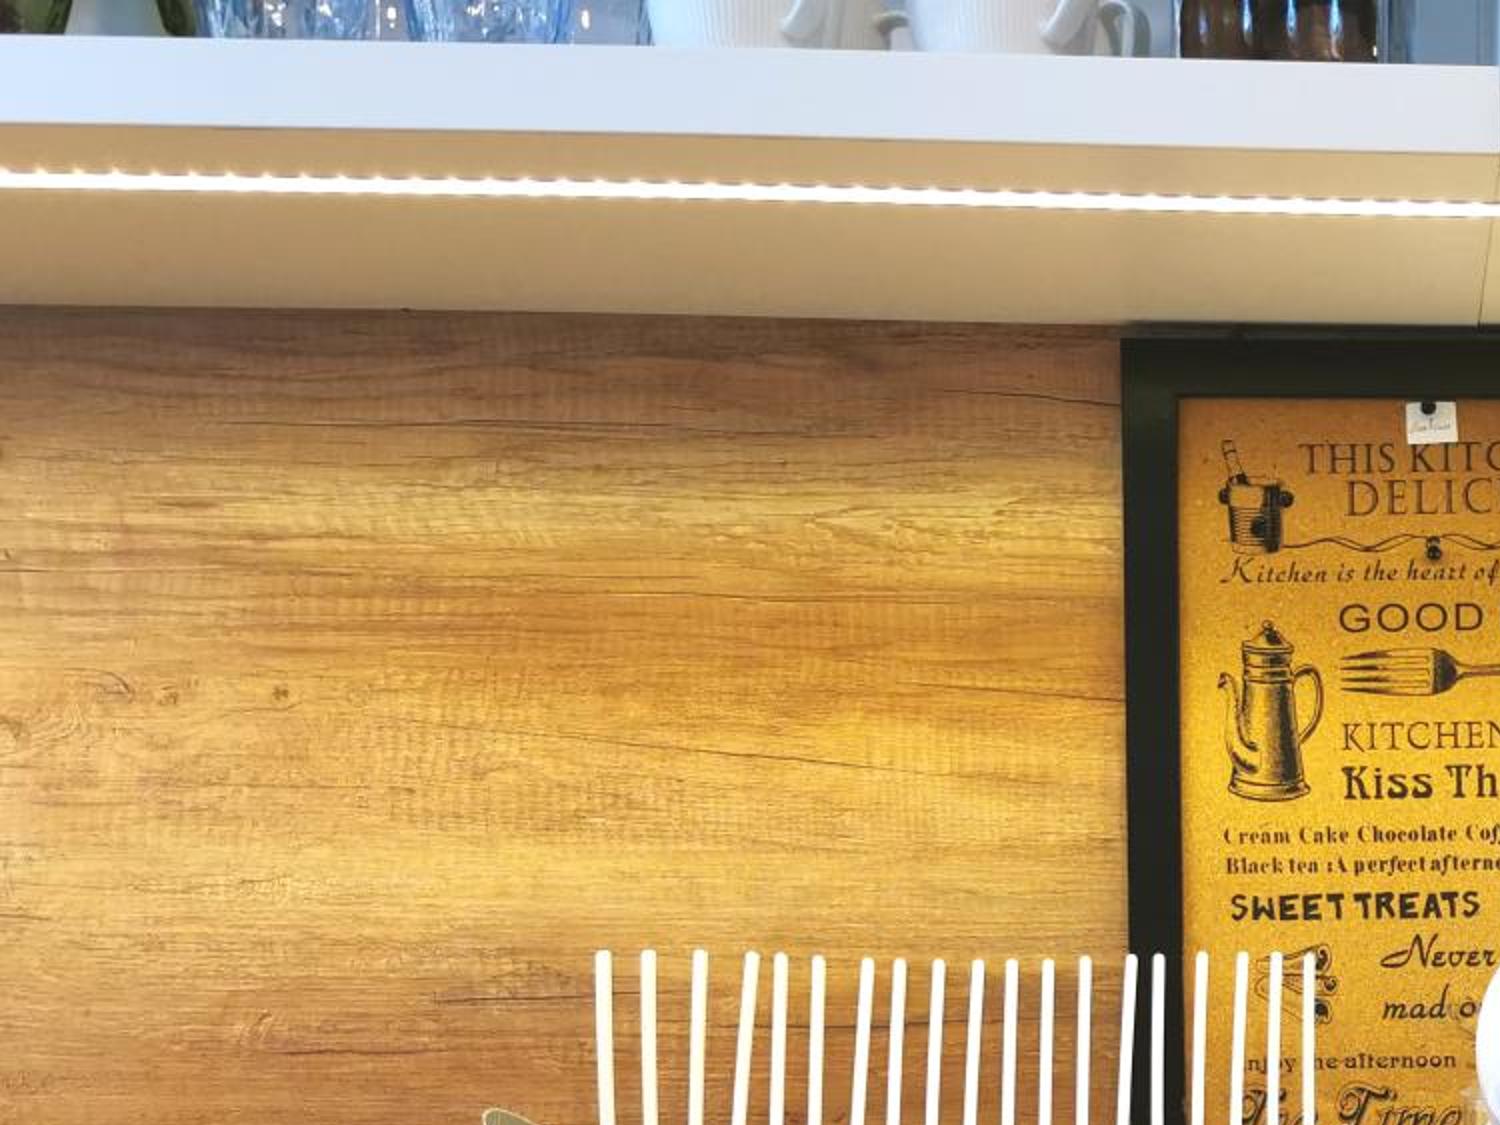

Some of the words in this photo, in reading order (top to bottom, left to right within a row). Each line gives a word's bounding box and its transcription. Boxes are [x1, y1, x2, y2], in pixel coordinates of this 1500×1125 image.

[1298, 442, 1395, 474] THIS
[1219, 556, 1328, 584] Kitchen
[1337, 563, 1355, 584] is
[1363, 559, 1399, 582] the
[1407, 559, 1467, 582] heart
[1472, 559, 1499, 587] of
[1339, 603, 1484, 633] GOOD
[1341, 765, 1434, 800] Kiss
[1223, 827, 1291, 845] Cream
[1298, 824, 1350, 844] Cake
[1356, 824, 1458, 844] Chocolate
[1226, 856, 1283, 875] Black
[1288, 857, 1319, 875] tea
[1354, 855, 1426, 877] perfect
[1231, 892, 1345, 921] SWEET
[1353, 891, 1481, 920] TREATS
[1380, 932, 1498, 969] Never
[1382, 983, 1448, 1020] mad
[1344, 1052, 1457, 1071] afternoon
